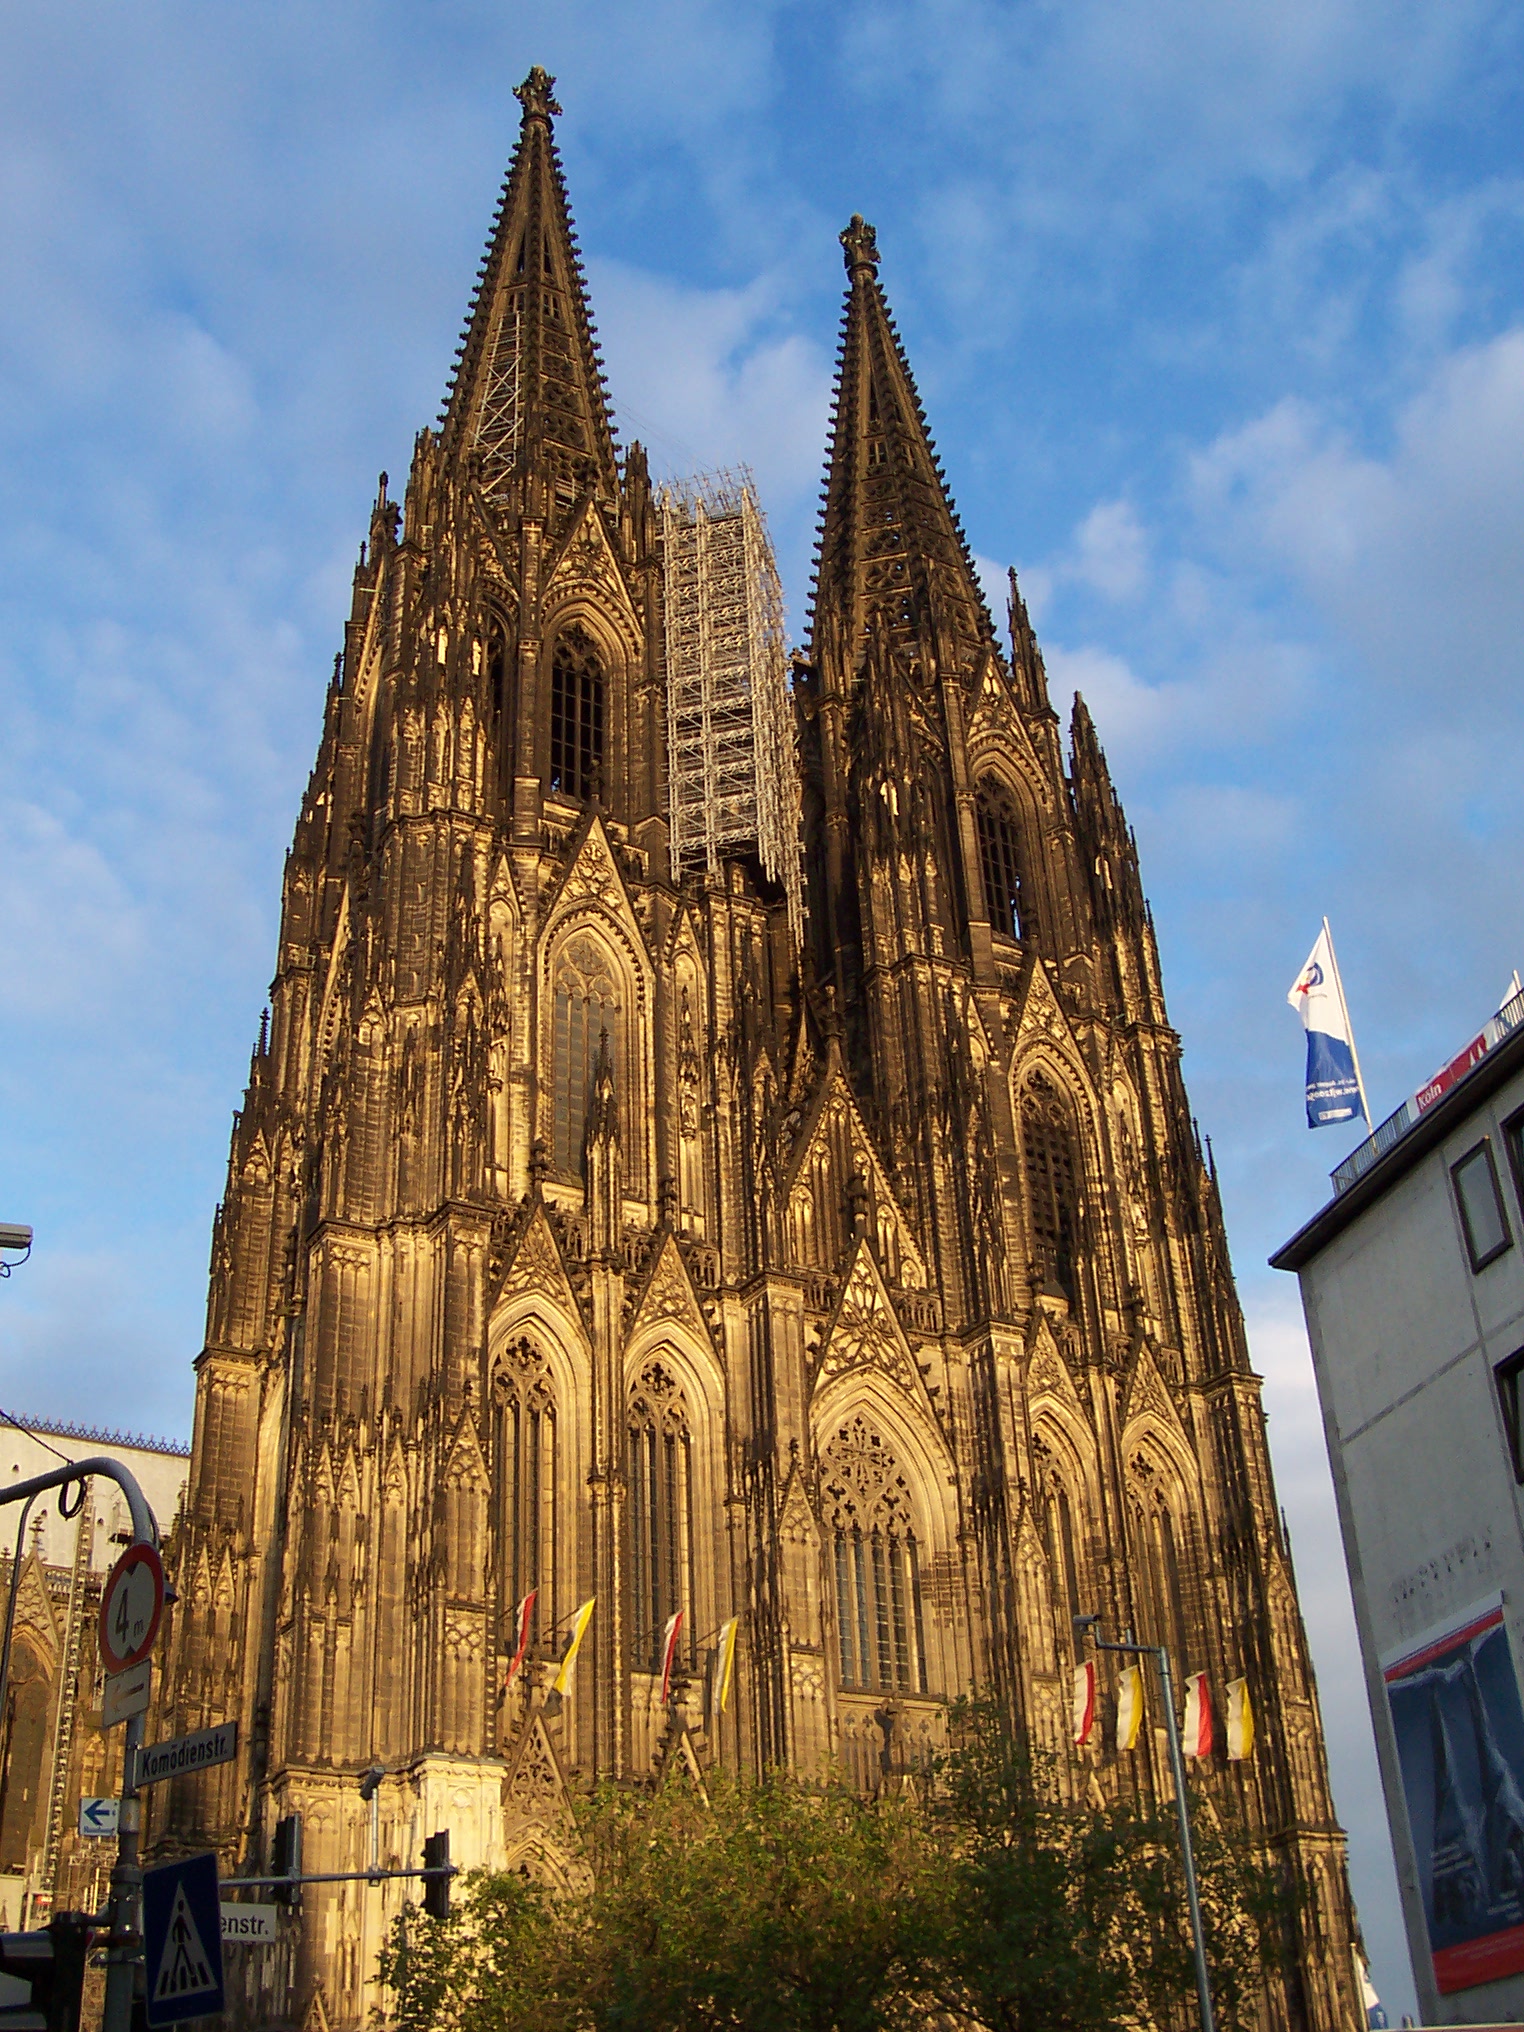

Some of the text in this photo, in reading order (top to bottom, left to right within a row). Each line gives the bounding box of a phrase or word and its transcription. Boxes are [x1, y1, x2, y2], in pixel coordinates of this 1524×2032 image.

[1418, 1083, 1442, 1110] Köln
[115, 1586, 129, 1644] 4
[142, 1732, 228, 1778] Komödienstr.
